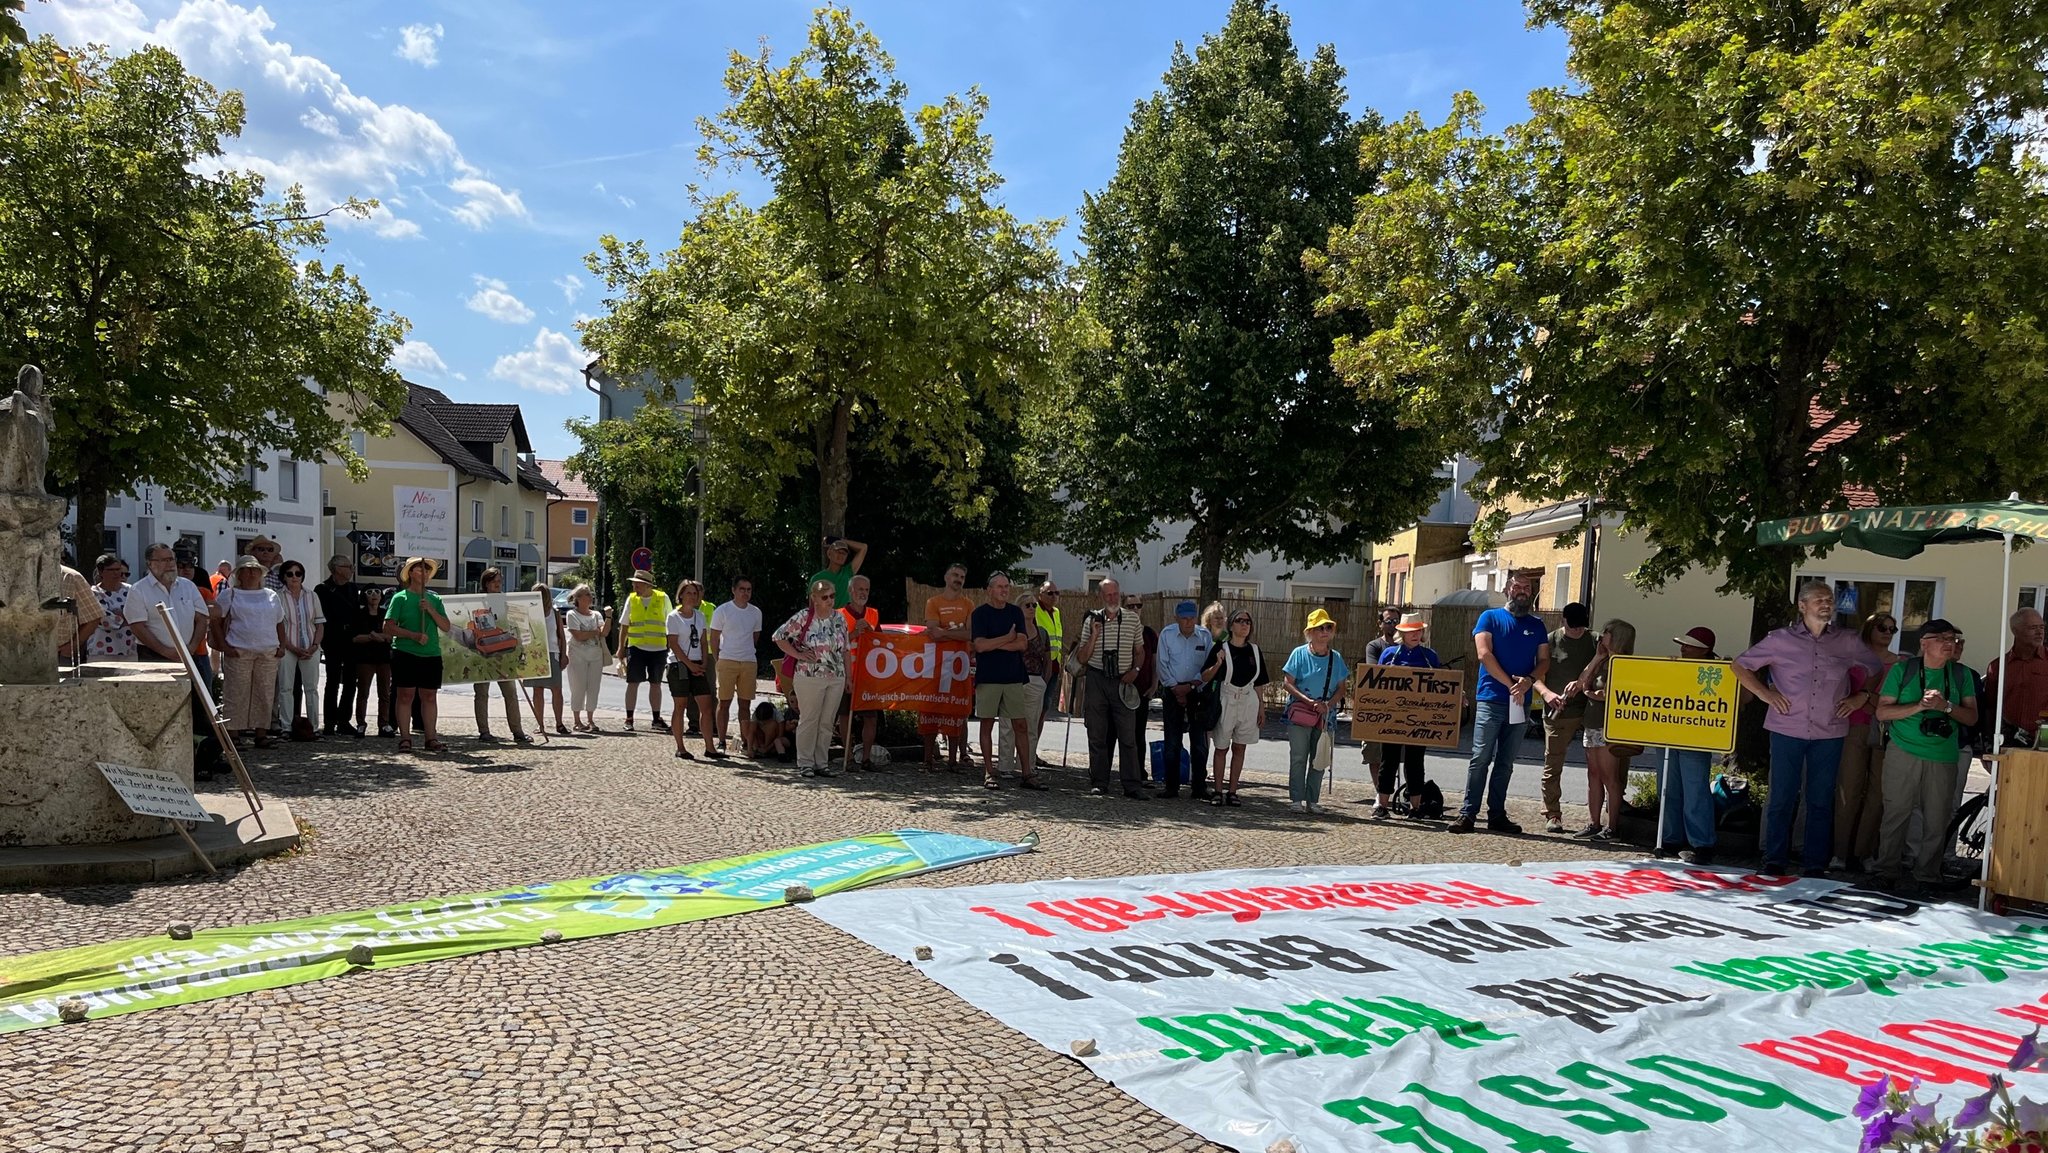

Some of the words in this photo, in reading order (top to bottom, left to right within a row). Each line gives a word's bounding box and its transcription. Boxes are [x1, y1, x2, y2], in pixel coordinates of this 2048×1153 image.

[412, 491, 436, 504] Nein
[1787, 512, 1851, 538] BUND
[865, 639, 970, 693] ödp
[1358, 667, 1413, 692] NATUR
[1615, 689, 1728, 714] Wenzenbach
[1356, 711, 1393, 723] STOPP
[1615, 708, 1649, 721] BUND
[1652, 712, 1726, 728] Naturschutz
[796, 866, 850, 880] UND
[1736, 887, 1921, 930] nter
[1361, 917, 1572, 964] und
[1550, 908, 1791, 943] Teer
[1670, 924, 2048, 996] ckerböden
[1467, 972, 1713, 1034] und
[1136, 995, 1520, 1062] Natur
